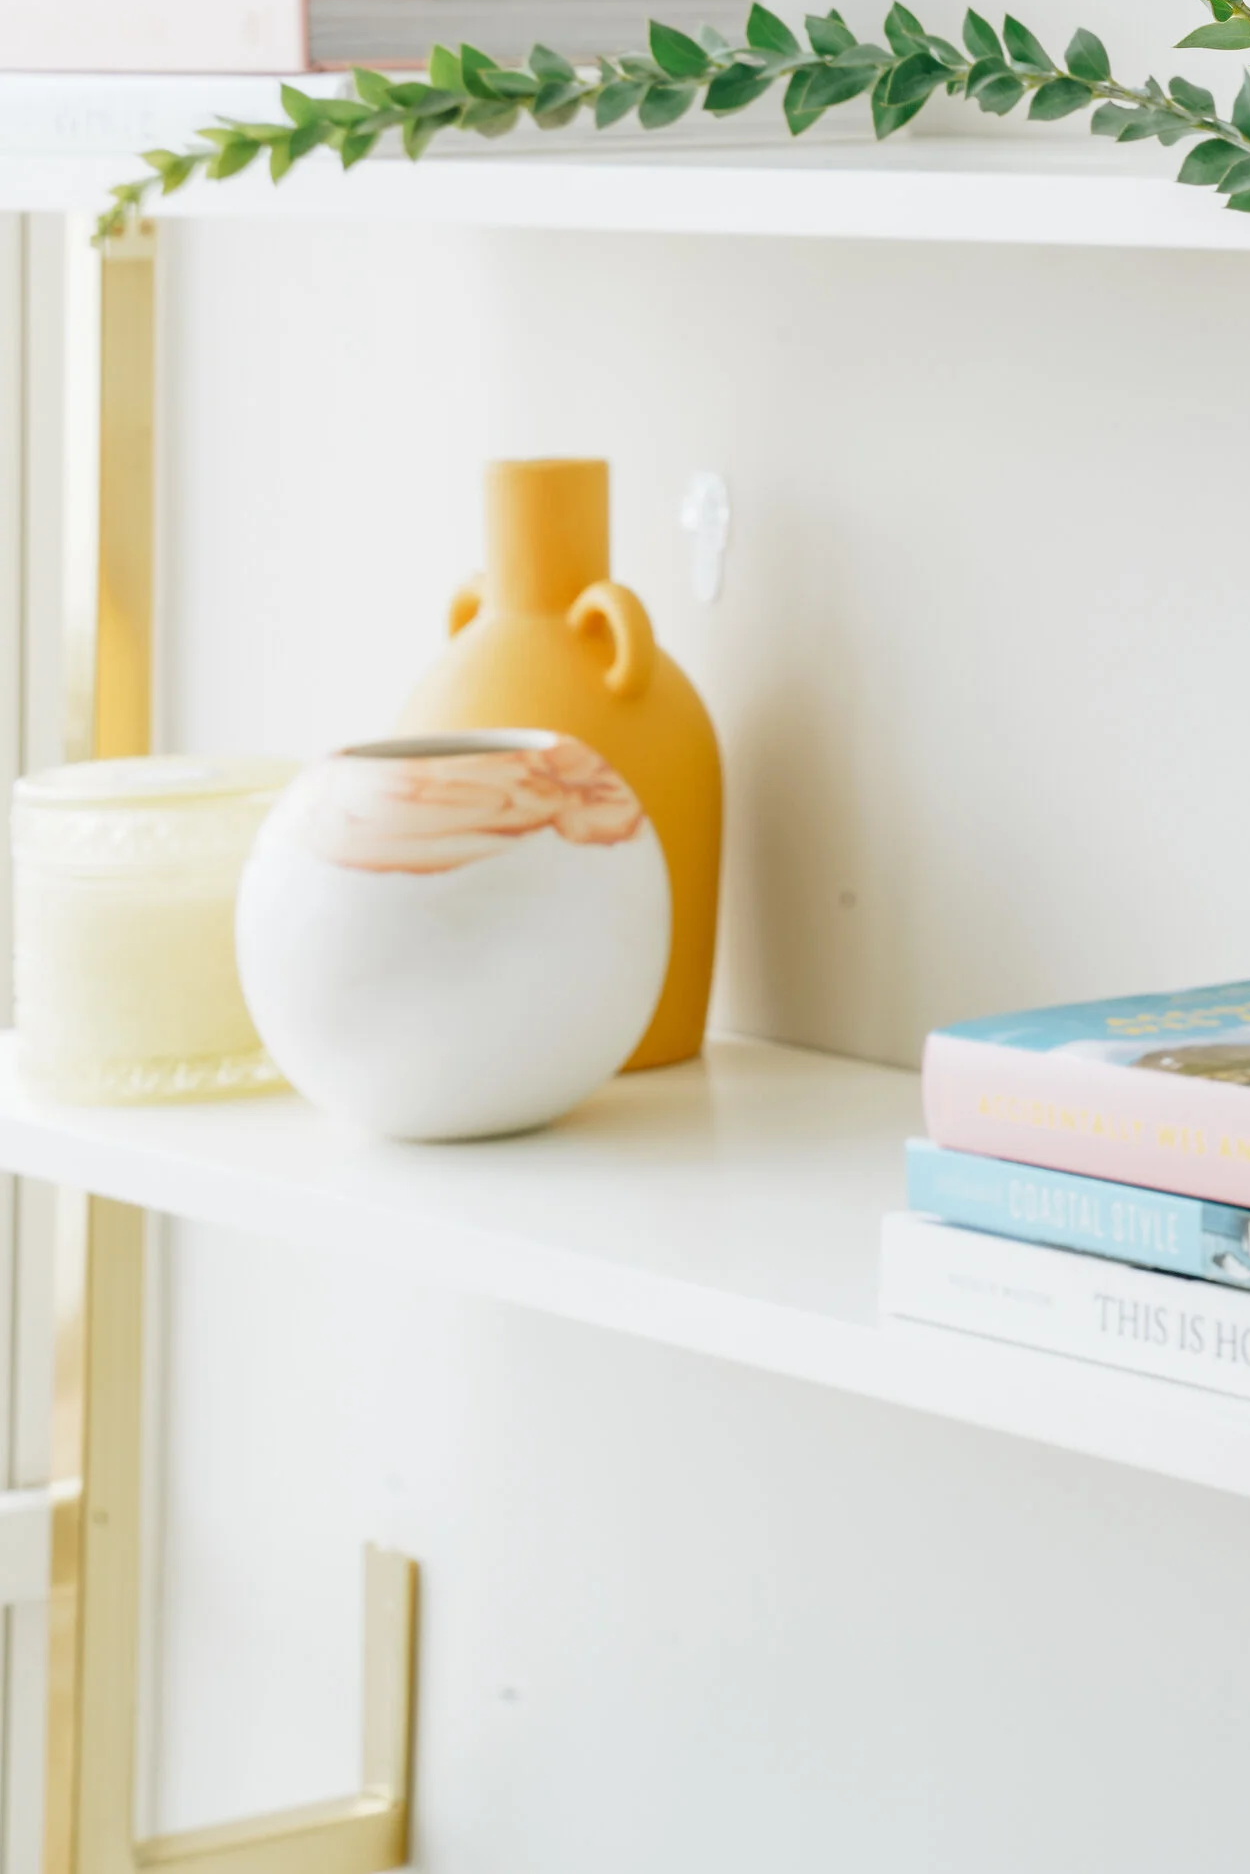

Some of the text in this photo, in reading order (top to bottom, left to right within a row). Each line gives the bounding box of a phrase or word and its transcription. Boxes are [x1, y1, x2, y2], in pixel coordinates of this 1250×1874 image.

[978, 1095, 1145, 1147] ACCIDENTALLY
[1156, 1129, 1207, 1157] WES
[1009, 1179, 1105, 1240] COASTAL
[1111, 1201, 1180, 1255] STYLE
[1094, 1293, 1168, 1346] THIS
[1179, 1312, 1205, 1354] IS
